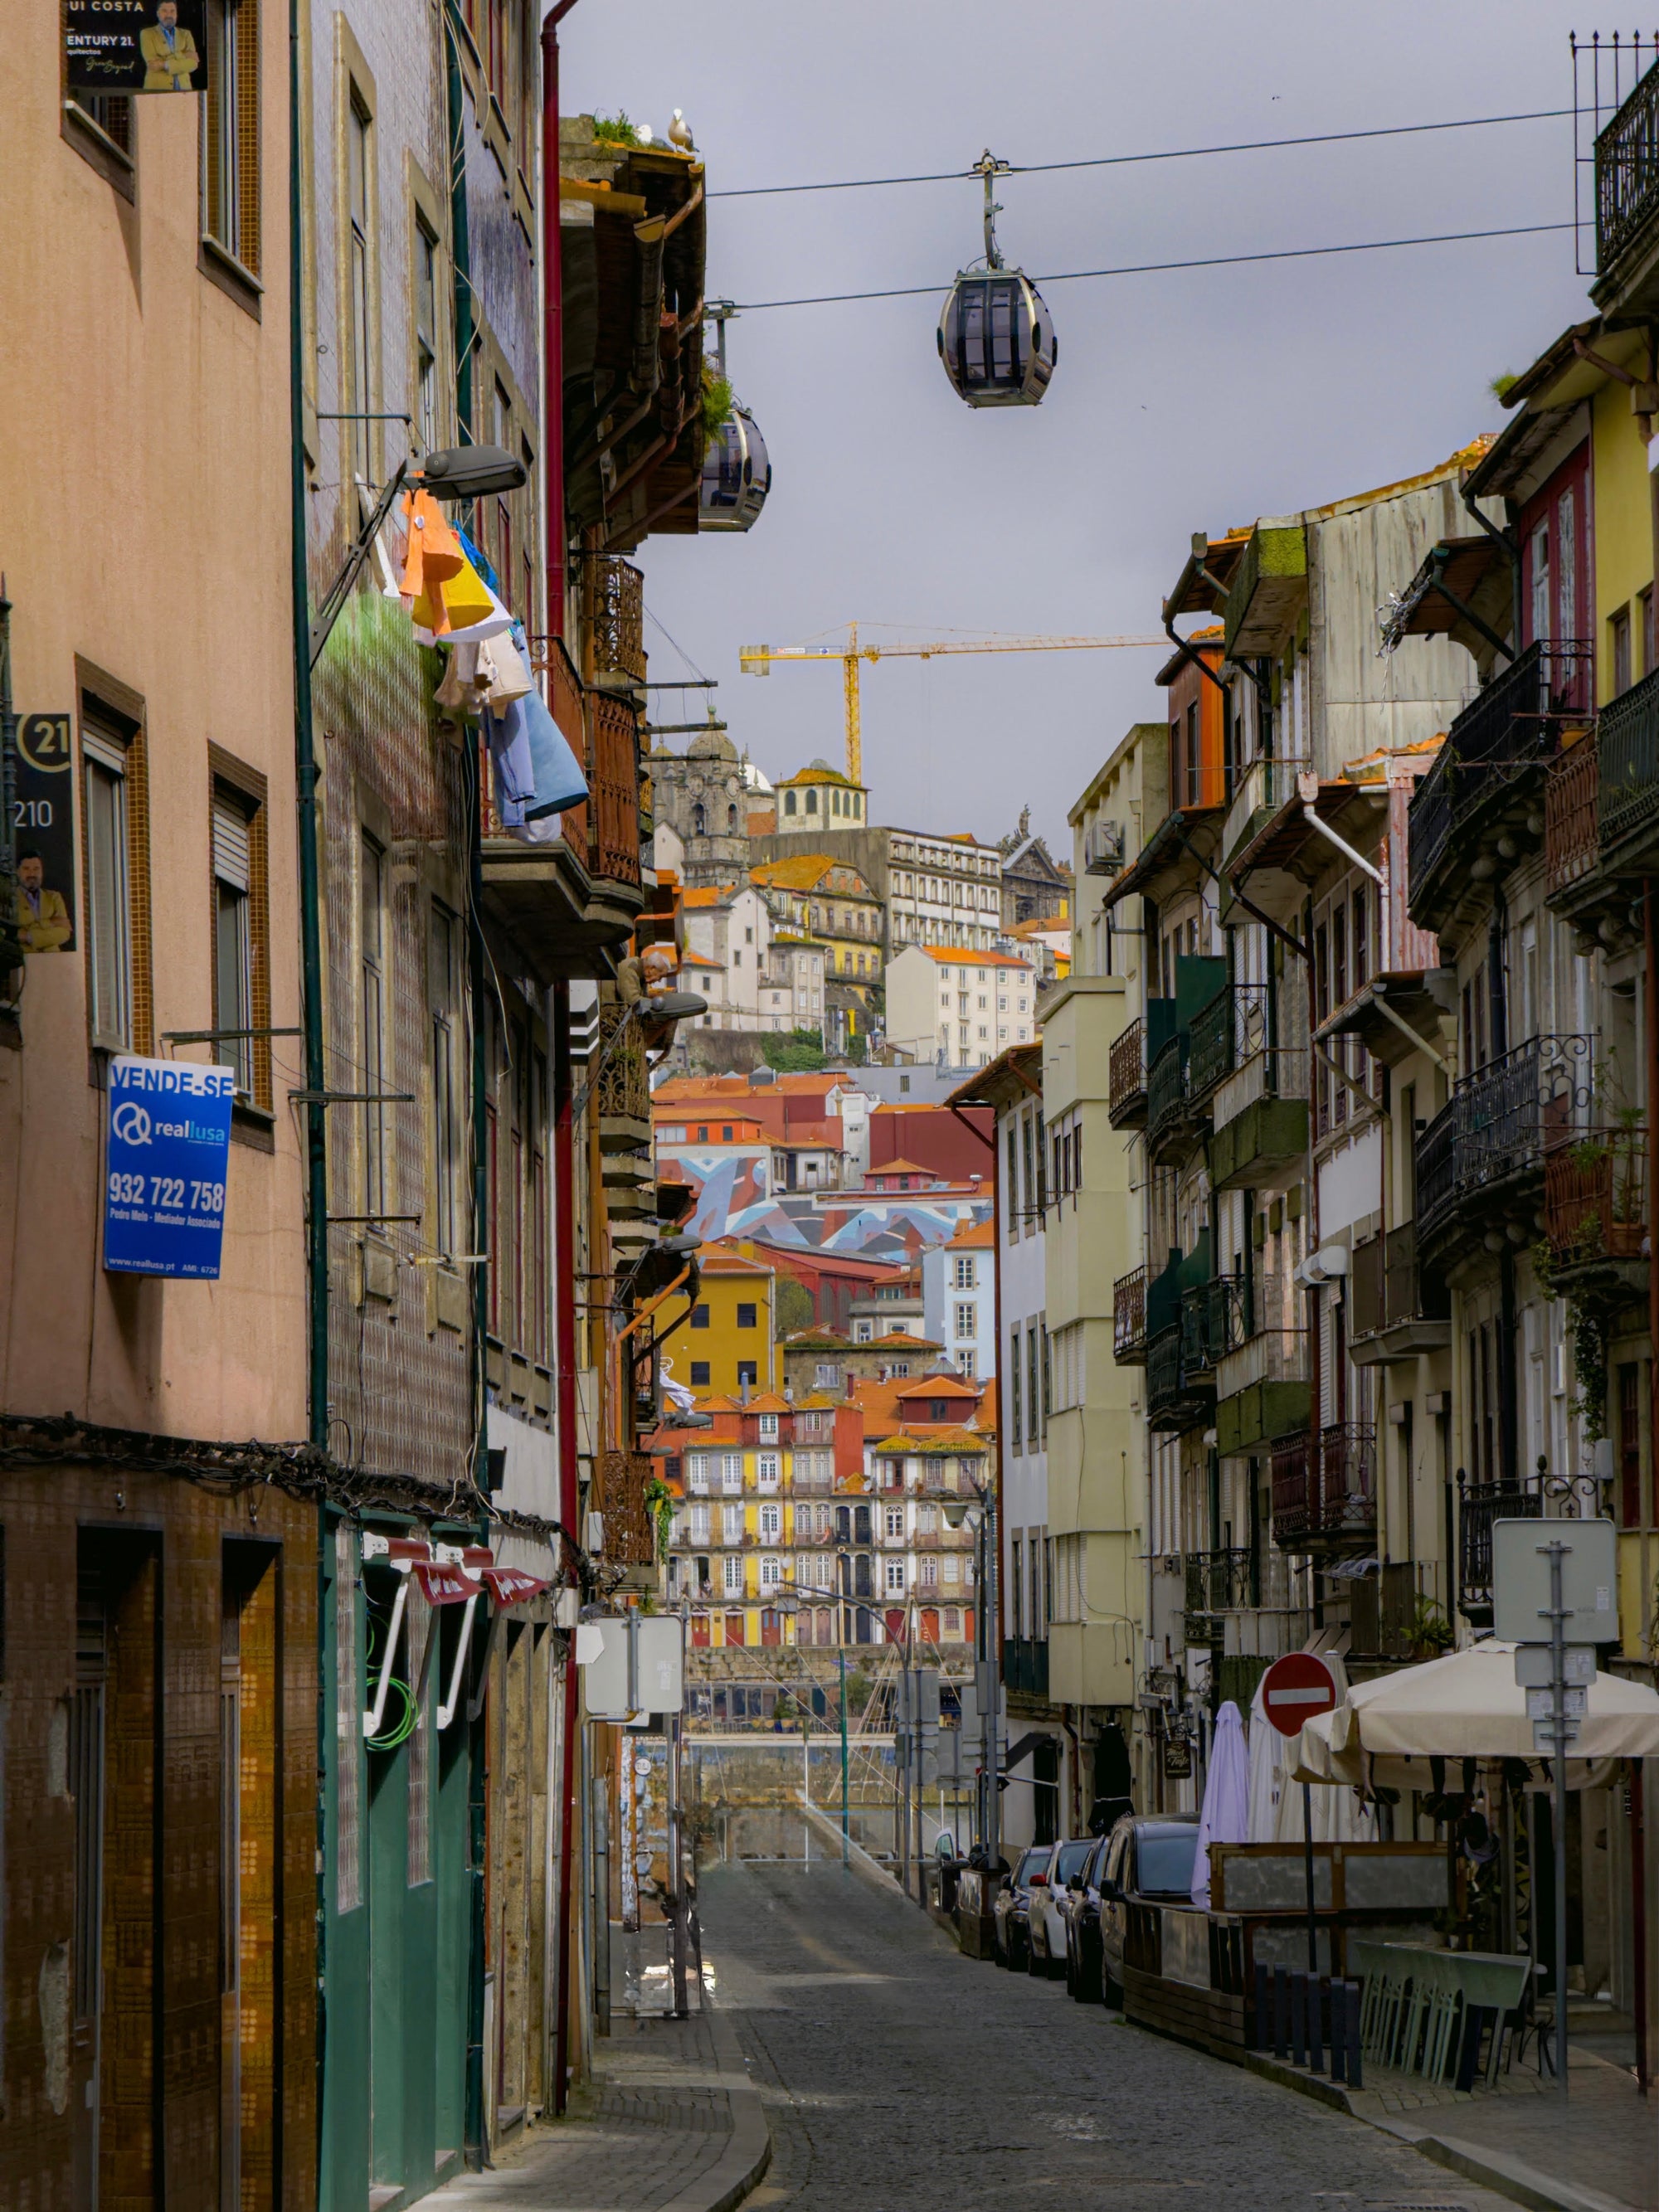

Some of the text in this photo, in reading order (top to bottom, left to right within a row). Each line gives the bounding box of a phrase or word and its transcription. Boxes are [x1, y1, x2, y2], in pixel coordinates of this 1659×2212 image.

[91, 1, 144, 12] COSTA
[14, 800, 52, 827] 210
[111, 1065, 233, 1096] VENDE-SE
[155, 1120, 225, 1142] reallusa
[109, 1172, 224, 1213] 932 722 758
[109, 1207, 129, 1220] Pedro
[154, 1211, 186, 1226] Mediador
[187, 1215, 221, 1229] Associado
[108, 1257, 175, 1271] www.reallusa.pt
[201, 1266, 218, 1274] 6726
